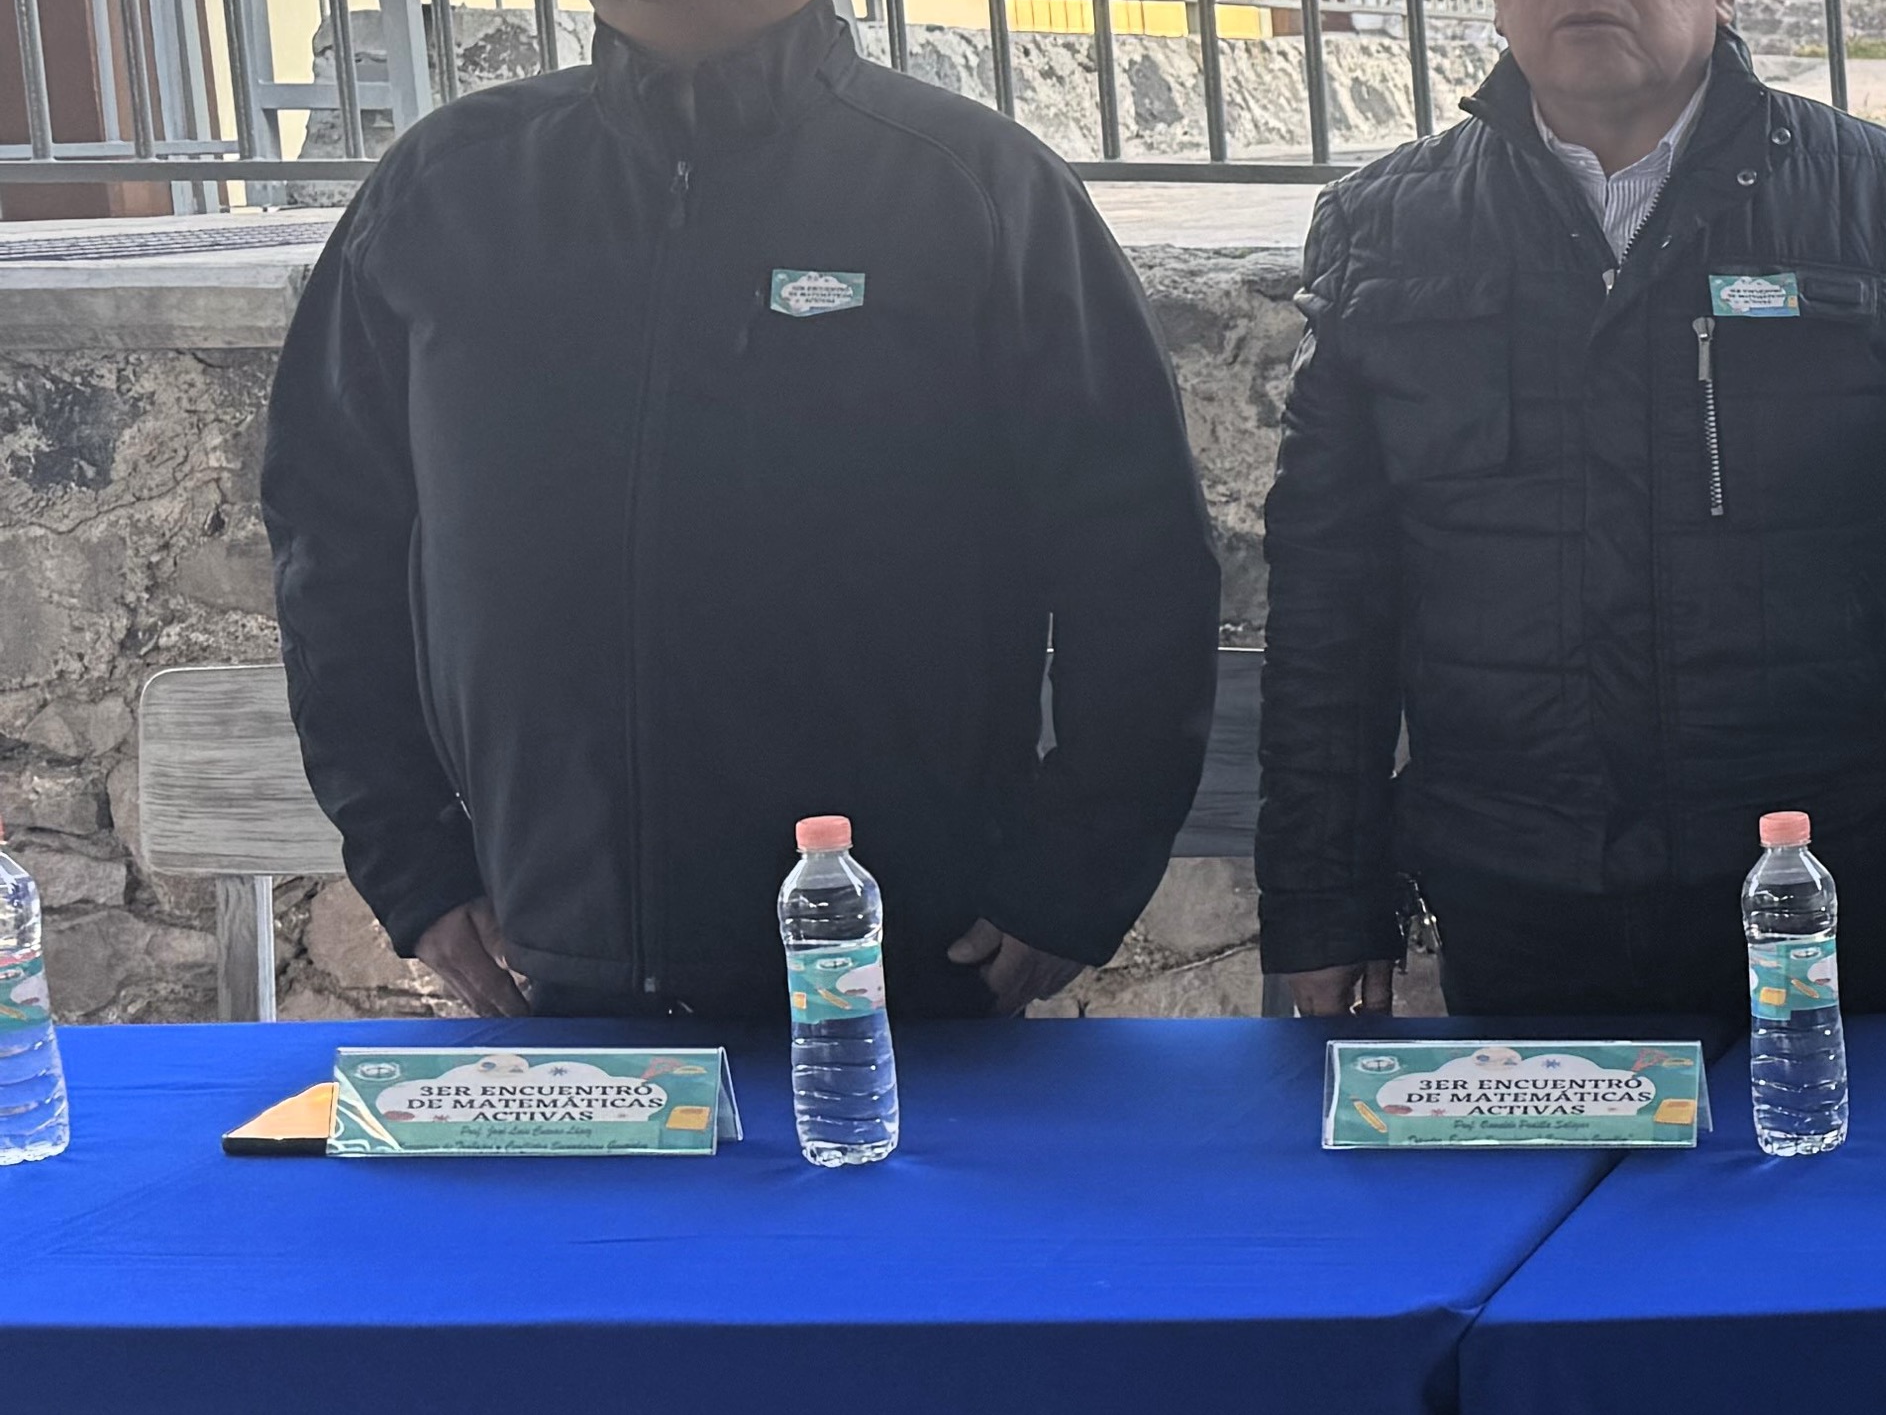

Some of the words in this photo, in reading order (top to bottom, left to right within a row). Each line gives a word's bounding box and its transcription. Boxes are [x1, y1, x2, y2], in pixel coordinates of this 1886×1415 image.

[1419, 1079, 1469, 1090] 3ER
[1478, 1078, 1643, 1090] ENCUENTRO
[420, 1085, 472, 1096] 3ER
[480, 1085, 653, 1096] ENCUENTRO
[1405, 1092, 1441, 1103] DE
[1449, 1087, 1652, 1103] MATEMÁTICAS
[407, 1098, 443, 1109] DE
[452, 1096, 664, 1109] MATEMÁTICAS
[1466, 1105, 1586, 1115] ACTIVAS
[472, 1111, 594, 1121] ACTIVAS
